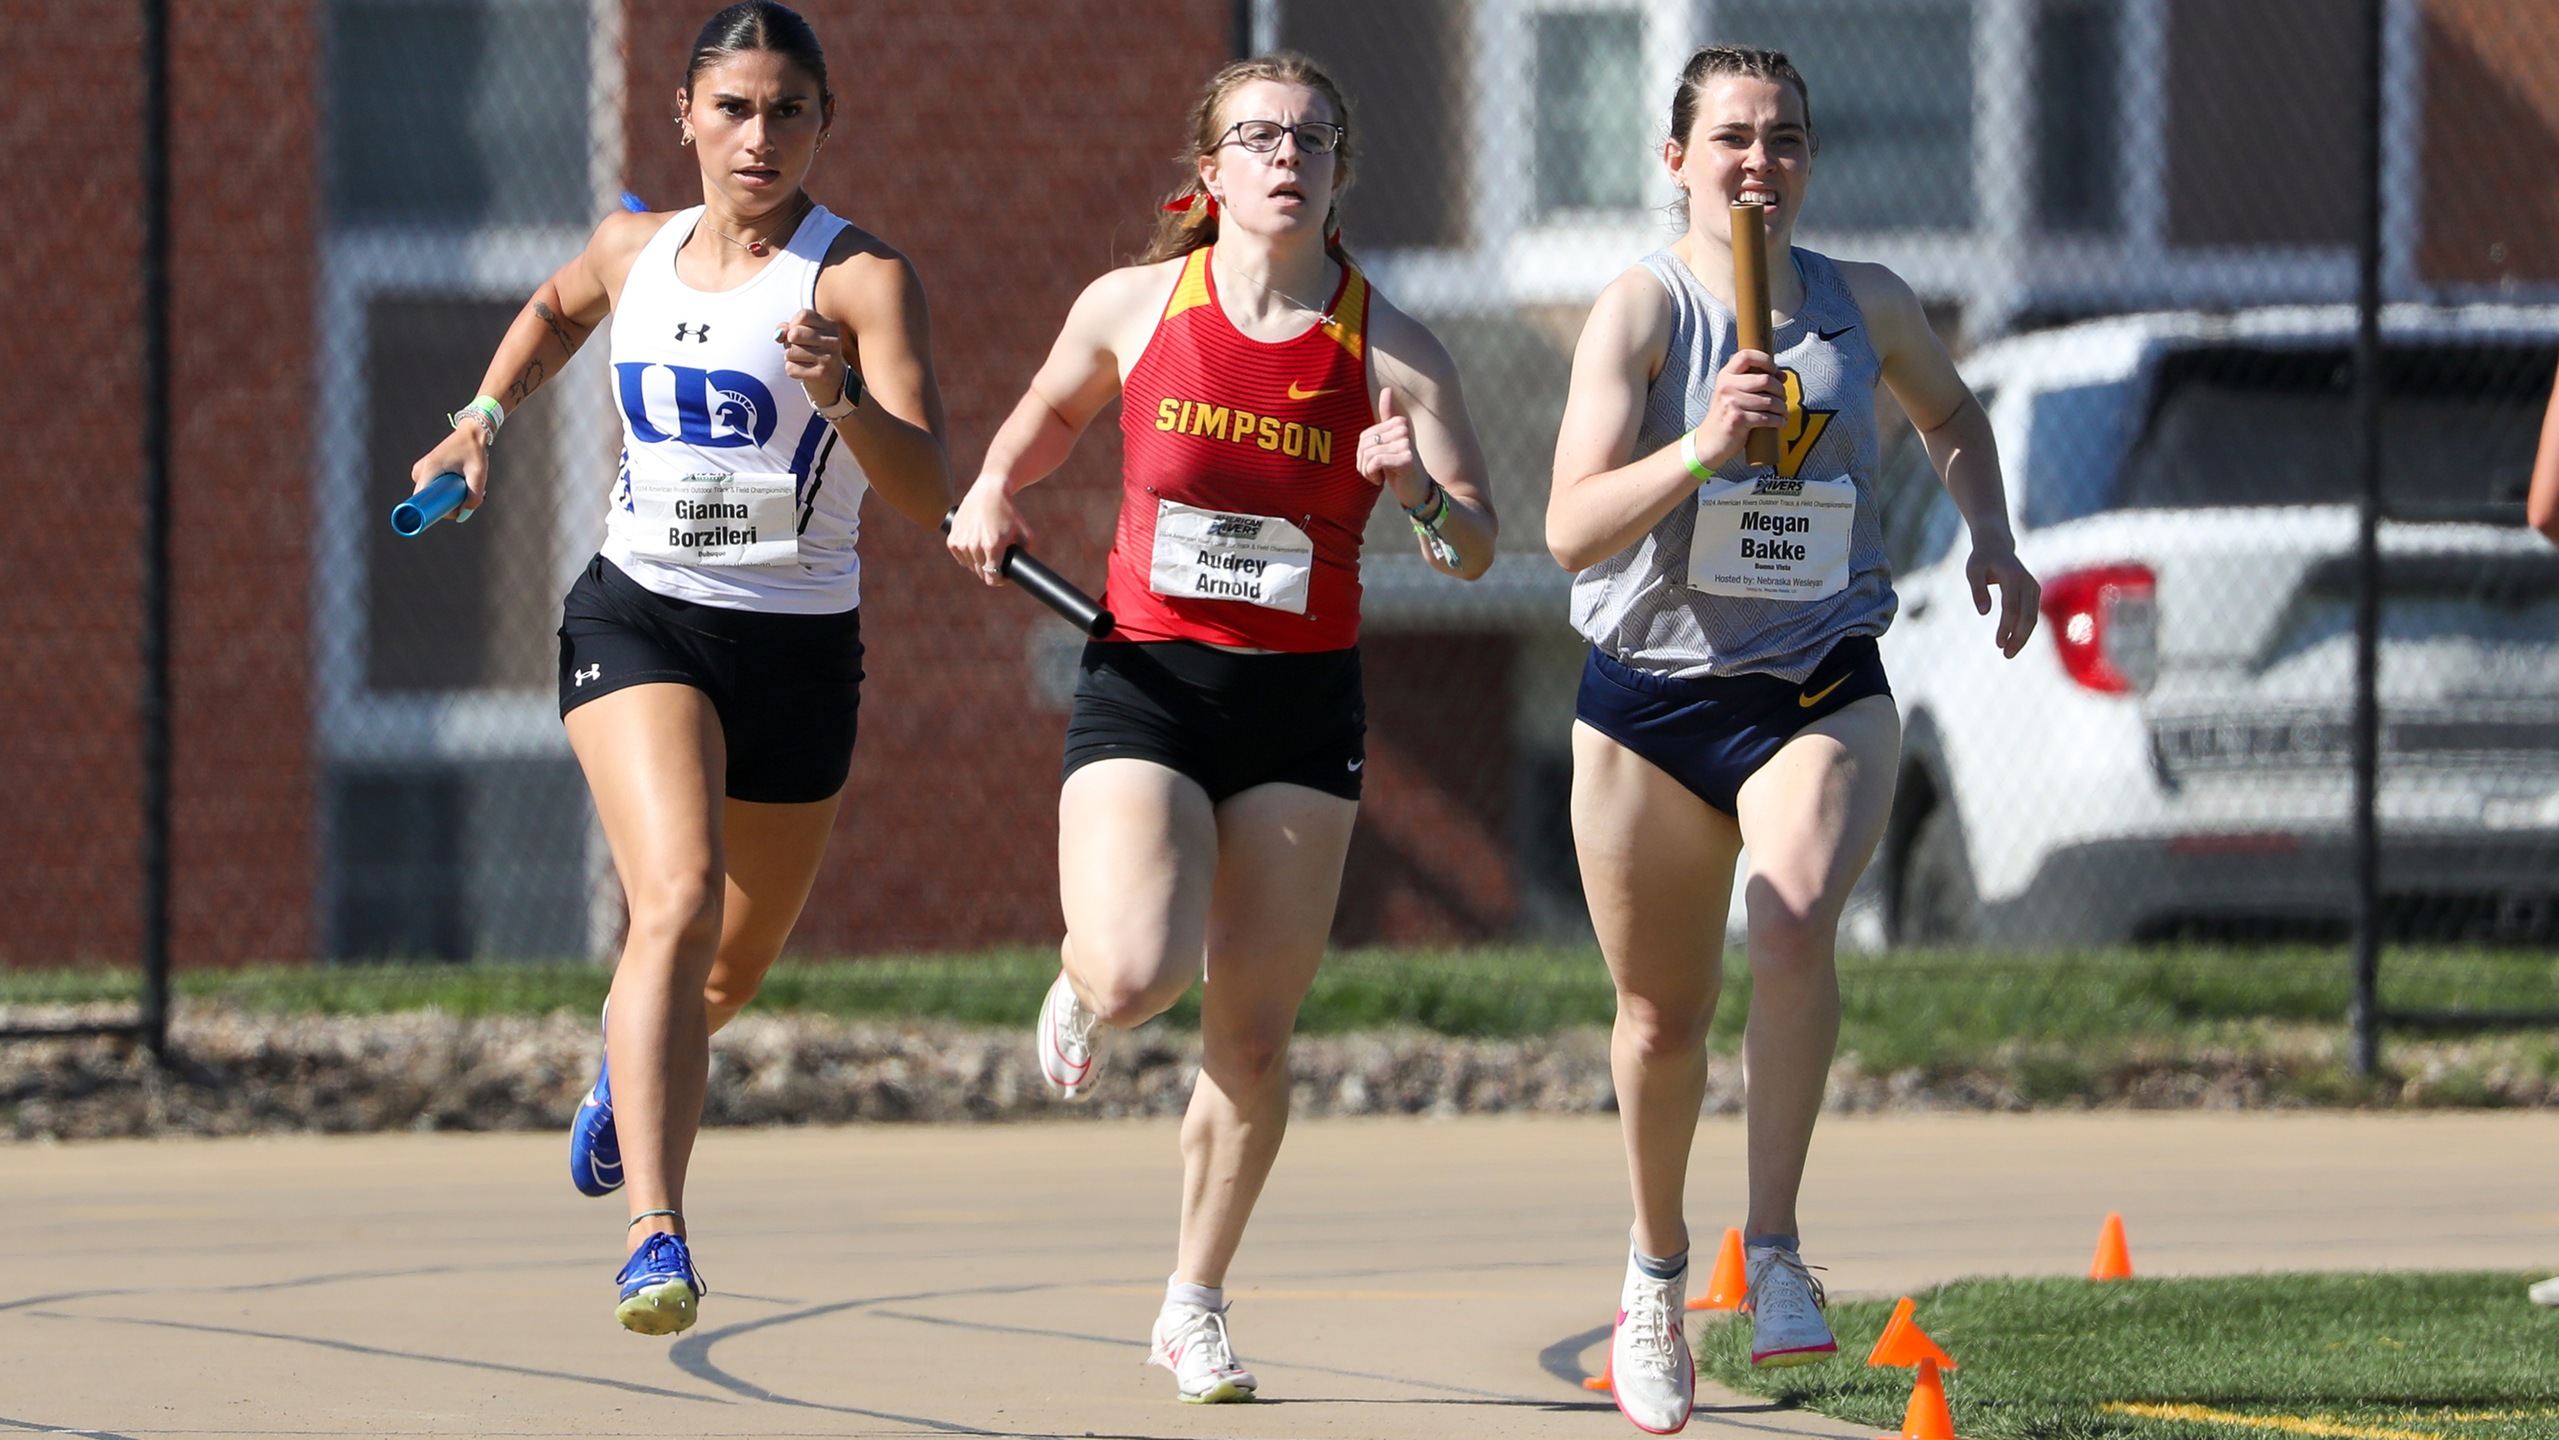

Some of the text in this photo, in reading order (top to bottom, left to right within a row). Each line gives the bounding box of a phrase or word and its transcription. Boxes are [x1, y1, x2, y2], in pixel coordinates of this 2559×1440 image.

[1155, 397, 1333, 465] SIMPSON
[649, 485, 672, 493] American
[751, 487, 793, 495] Championships
[1752, 480, 1804, 494] RIVERS
[675, 499, 749, 520] Gianna
[1814, 501, 1853, 509] Championships
[1739, 511, 1810, 536] Megan
[669, 526, 757, 548] Borzileri
[698, 550, 727, 558] Dubuque
[1741, 538, 1806, 561] Bakke
[1196, 550, 1268, 578] Audrey
[1754, 562, 1775, 570] Buena
[1195, 573, 1261, 599] Arnold
[1715, 574, 1824, 588] Hosted by: Nebraska Wesleyan
